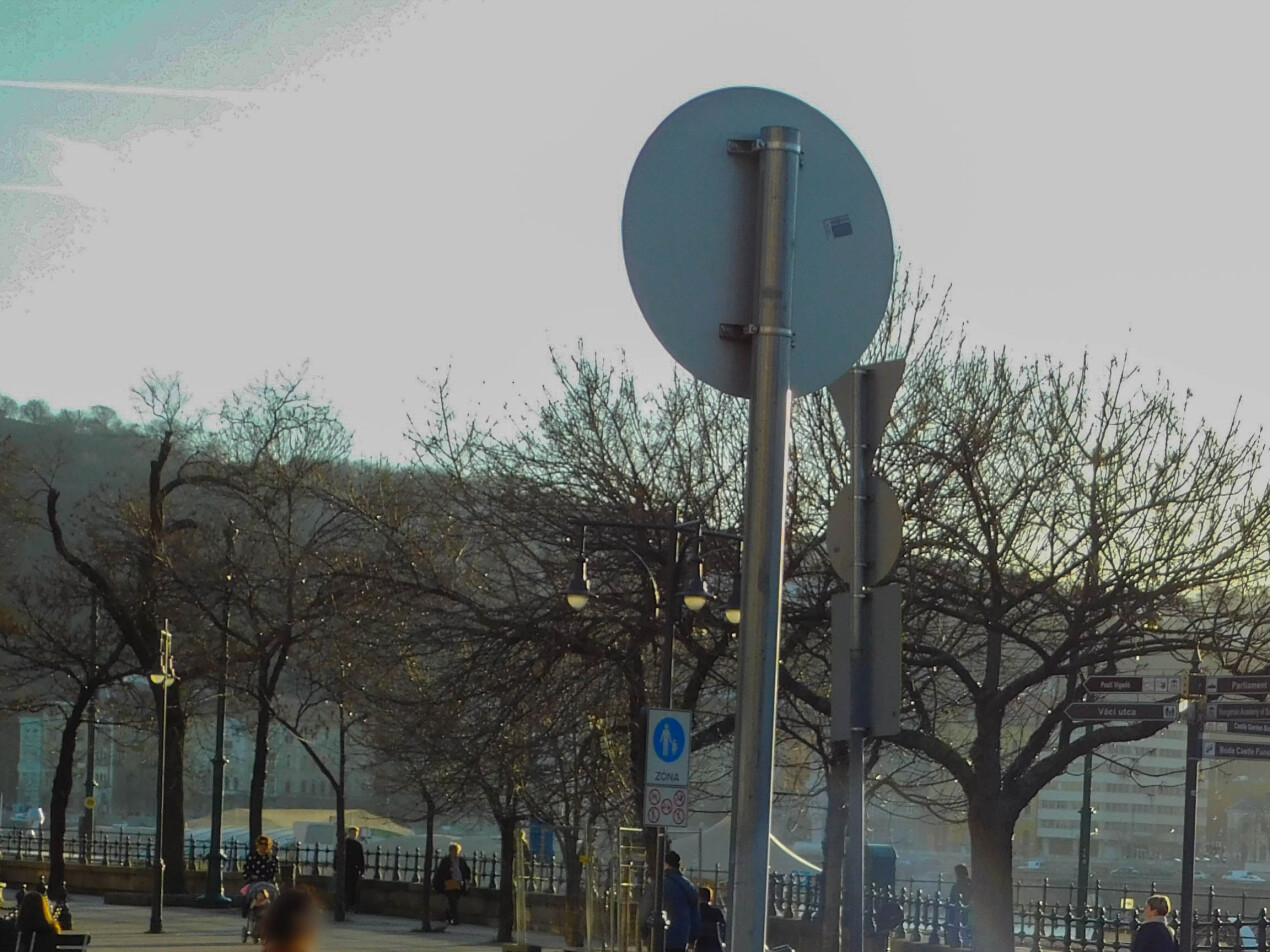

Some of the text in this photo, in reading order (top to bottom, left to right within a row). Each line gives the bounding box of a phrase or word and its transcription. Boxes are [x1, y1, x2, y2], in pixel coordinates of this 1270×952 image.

[1231, 681, 1268, 690] Parliament
[1117, 708, 1137, 716] utca
[1219, 745, 1235, 754] Buda
[1236, 747, 1254, 755] Castle
[655, 770, 680, 782] ZÓNA
